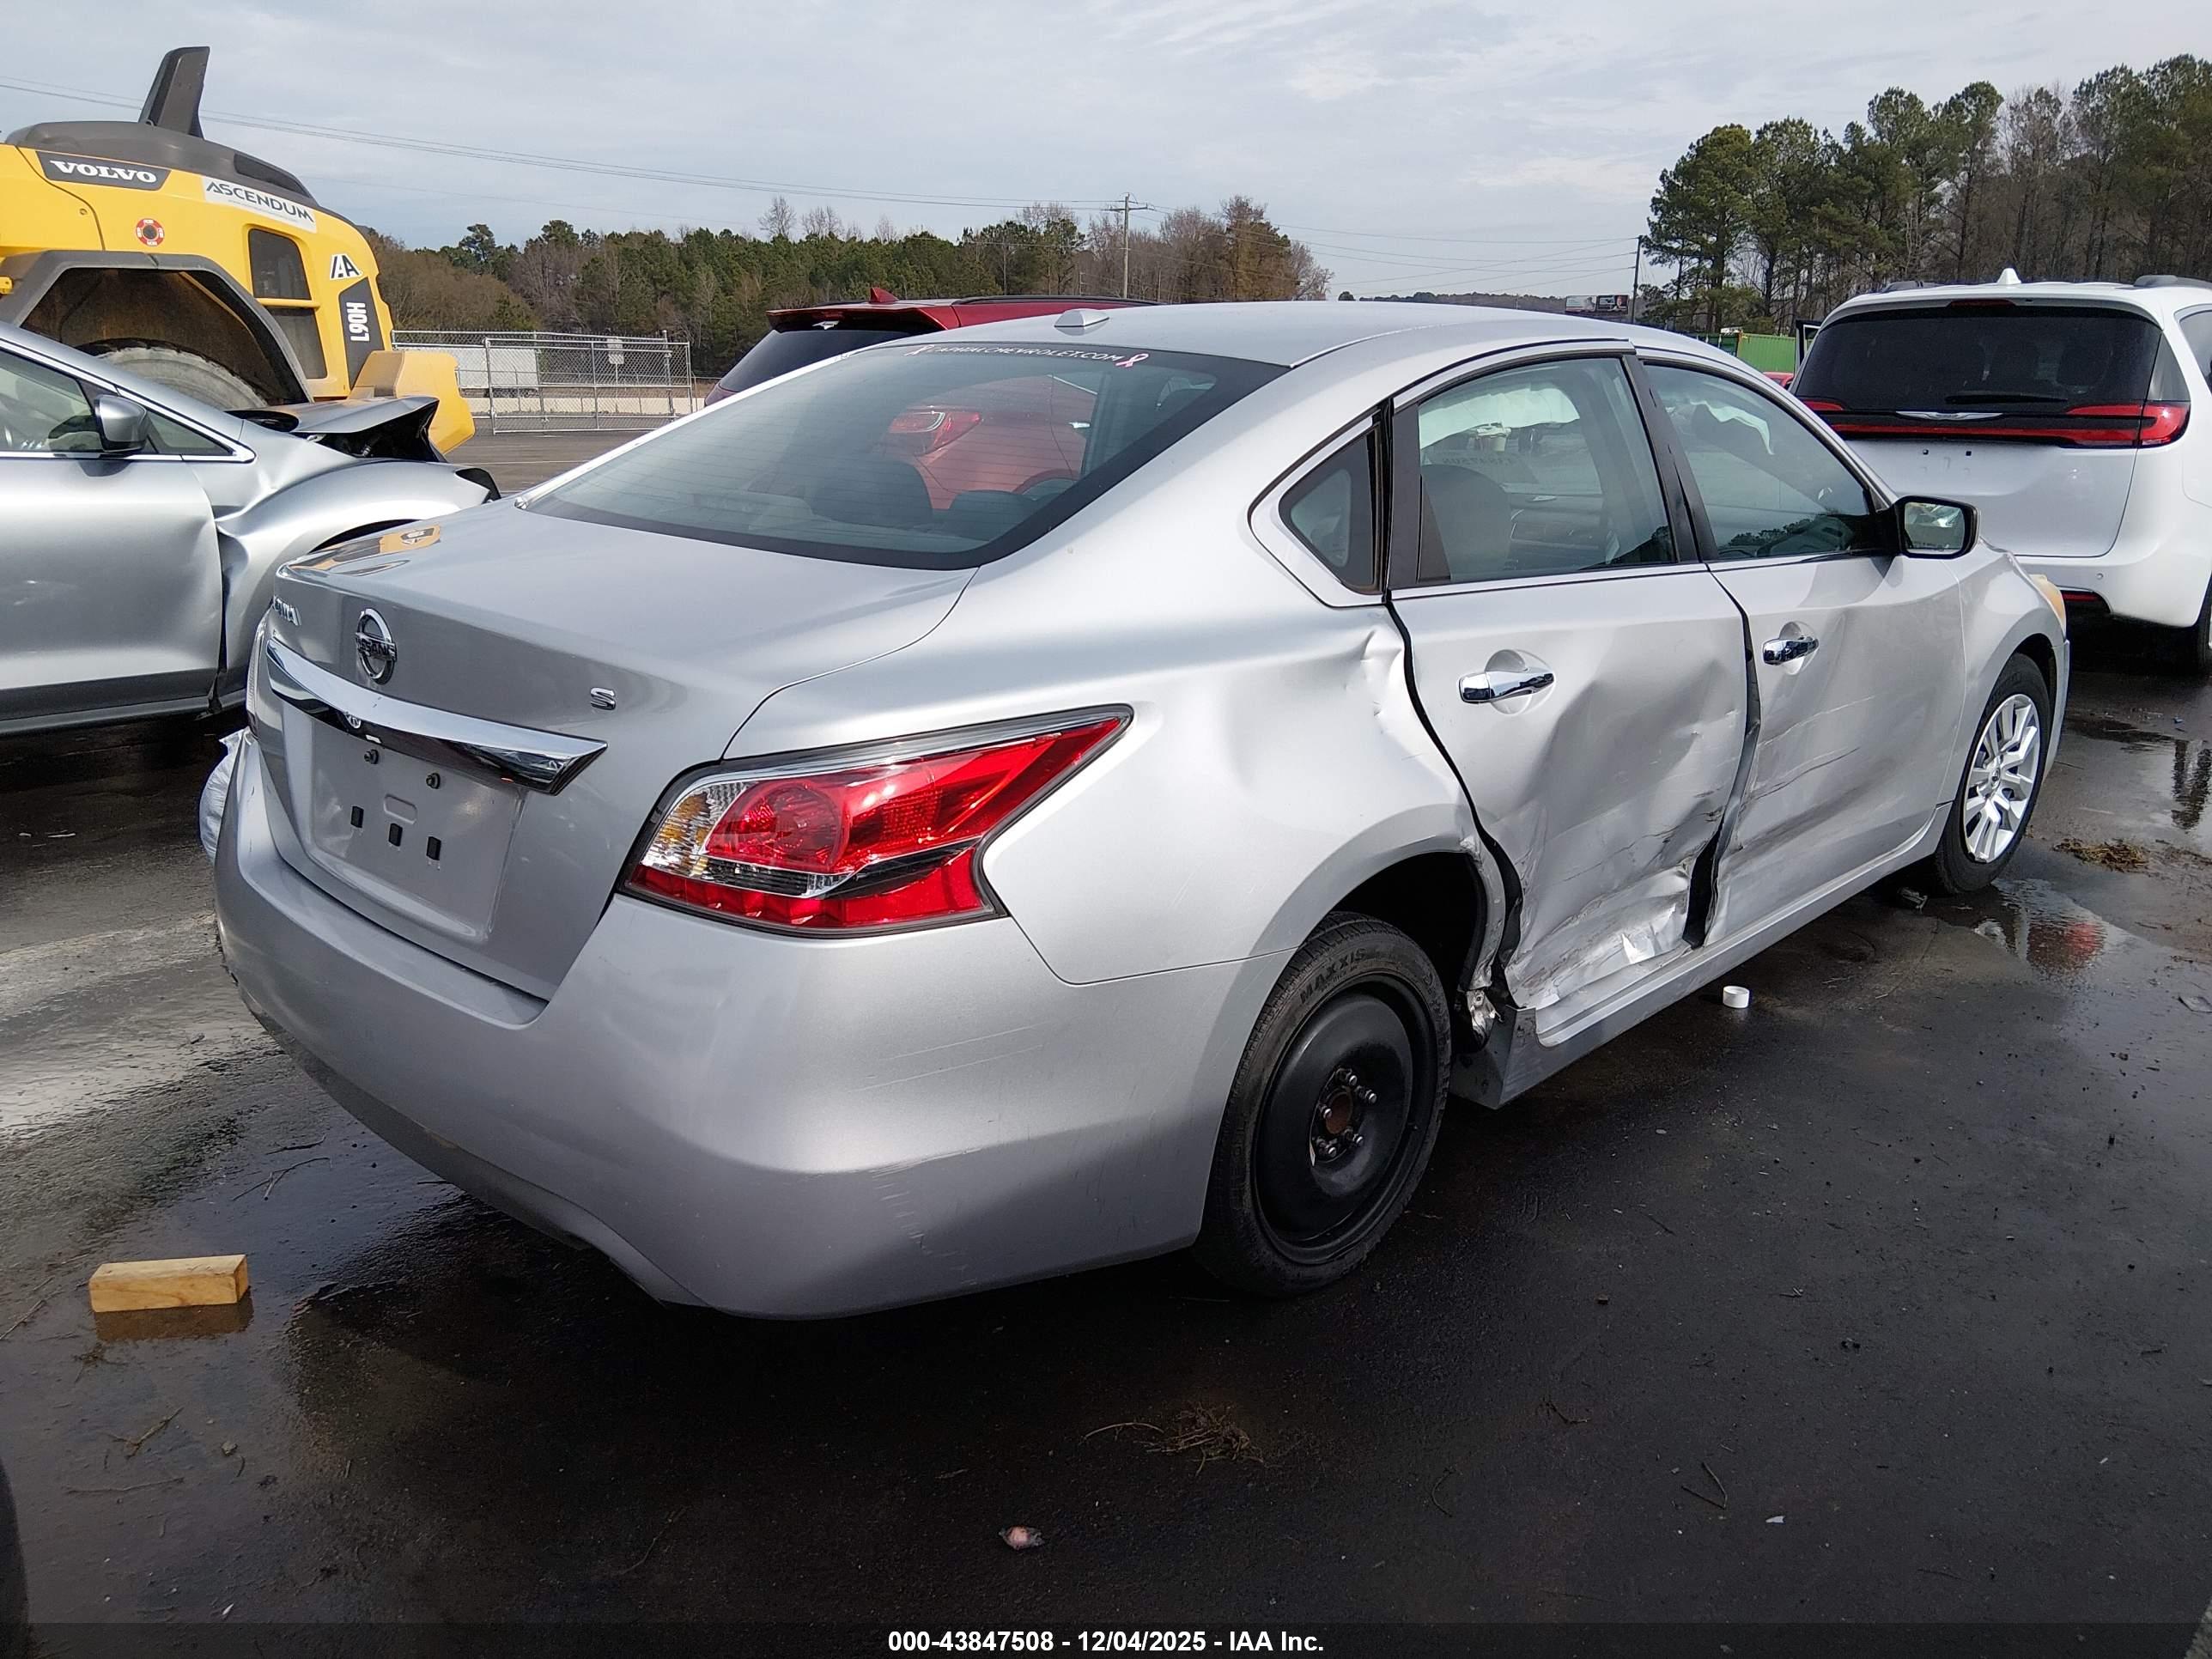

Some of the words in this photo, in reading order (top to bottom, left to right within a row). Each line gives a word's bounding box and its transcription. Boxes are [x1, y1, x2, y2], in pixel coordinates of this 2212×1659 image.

[50, 160, 157, 183] VOLVO
[206, 181, 314, 222] ASCENDUM
[346, 302, 370, 342] L90H
[590, 687, 616, 711] S
[1299, 947, 1367, 1006] MAXXIS
